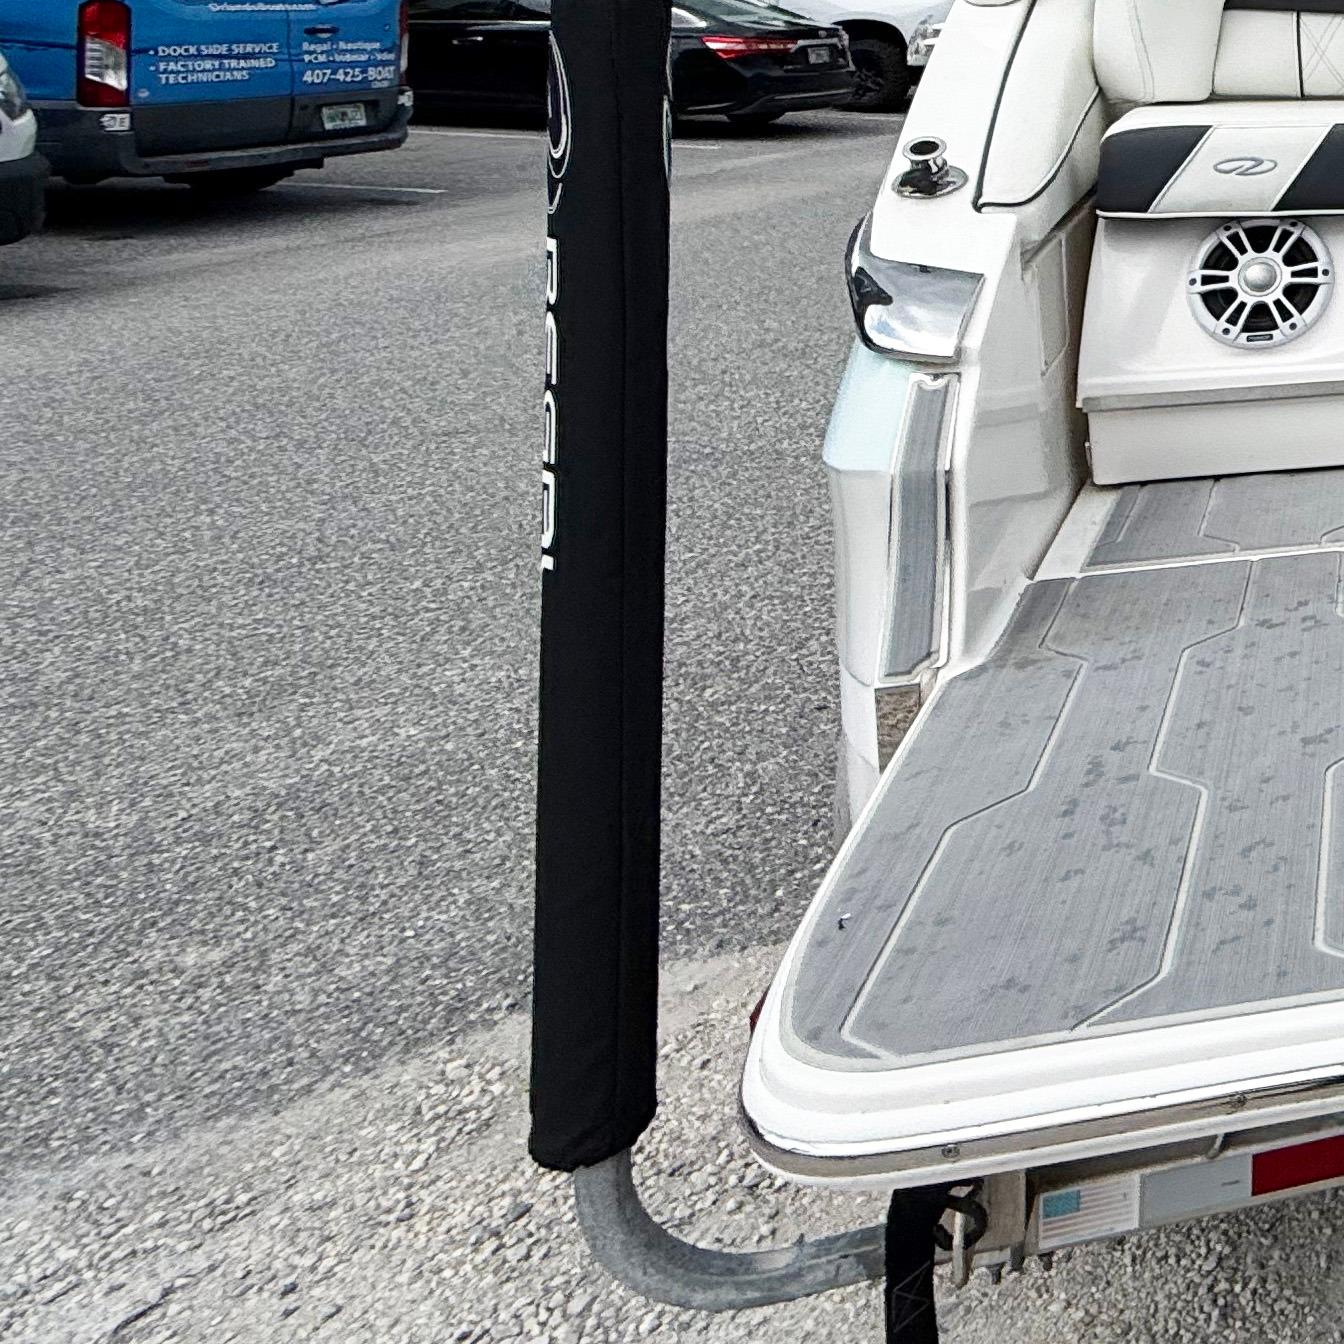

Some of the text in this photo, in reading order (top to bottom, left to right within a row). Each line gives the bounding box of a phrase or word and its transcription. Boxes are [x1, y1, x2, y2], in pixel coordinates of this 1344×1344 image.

[158, 42, 280, 56] DOCK SIDE SERVICE
[159, 58, 276, 72] FACTORY TRAINED
[159, 70, 250, 84] TECHNICIANS
[303, 65, 396, 84] 407-425-BOAT
